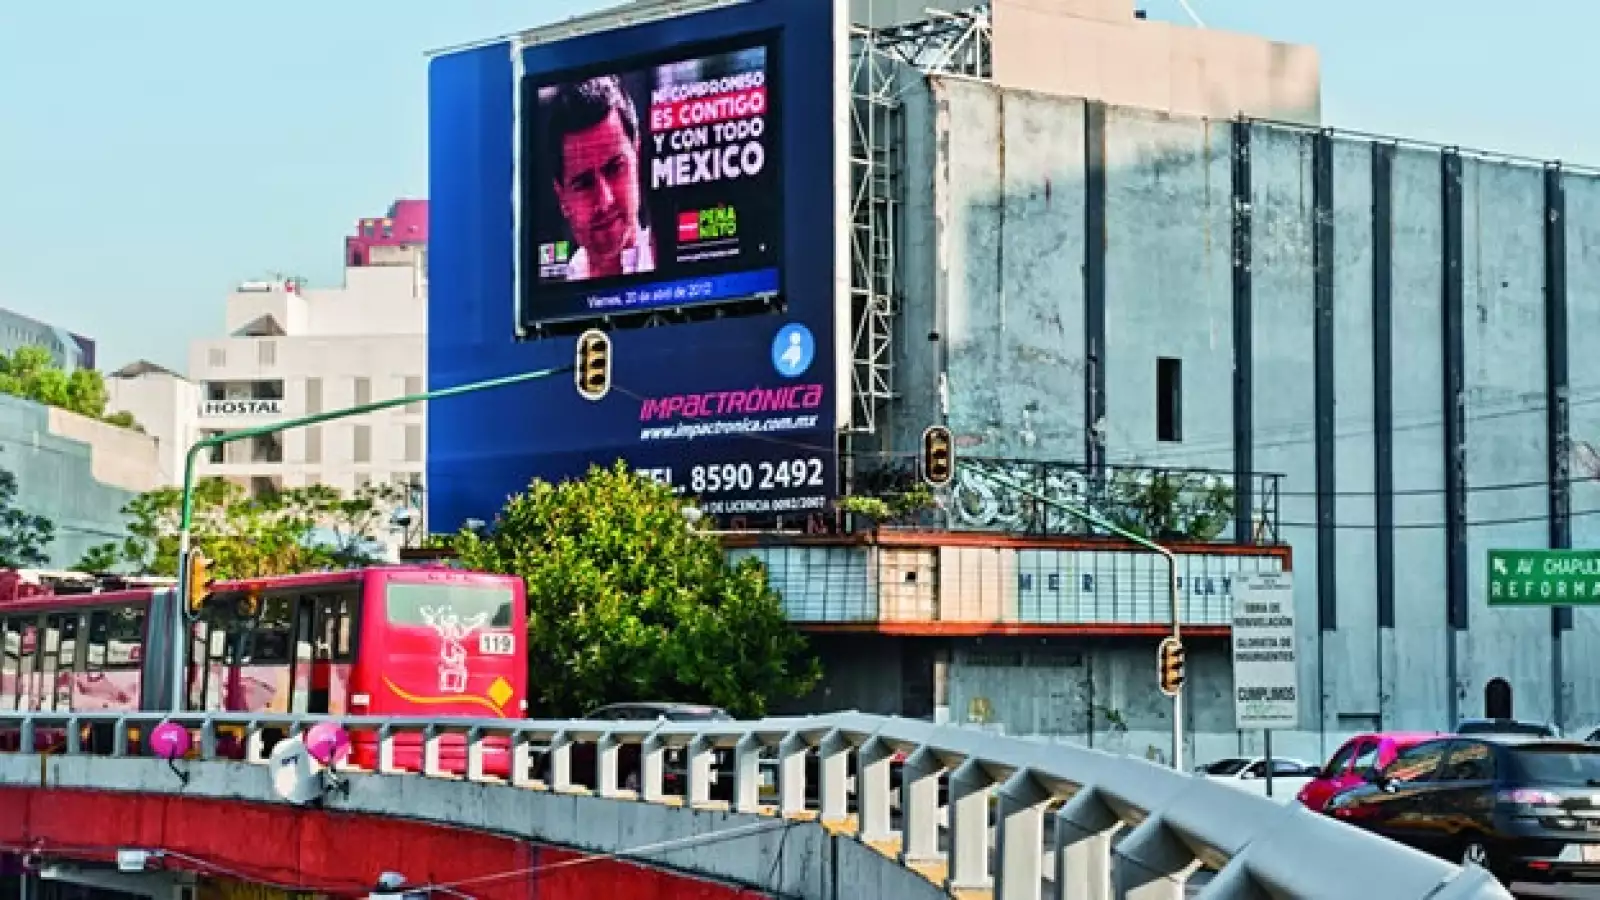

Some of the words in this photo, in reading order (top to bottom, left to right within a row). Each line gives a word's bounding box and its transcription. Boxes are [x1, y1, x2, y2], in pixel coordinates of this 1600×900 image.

[652, 107, 673, 131] ES
[680, 91, 764, 125] CONTIGO
[653, 133, 665, 152] Y
[671, 125, 708, 150] CON
[713, 115, 764, 142] TODO
[651, 140, 765, 189] MEXICO
[207, 402, 281, 414] HOSTAL
[640, 414, 819, 441] www.impactronica.com.mx
[691, 463, 753, 492] 8590
[758, 456, 824, 490] 2492
[1517, 558, 1534, 575] AV
[483, 635, 511, 652] 119
